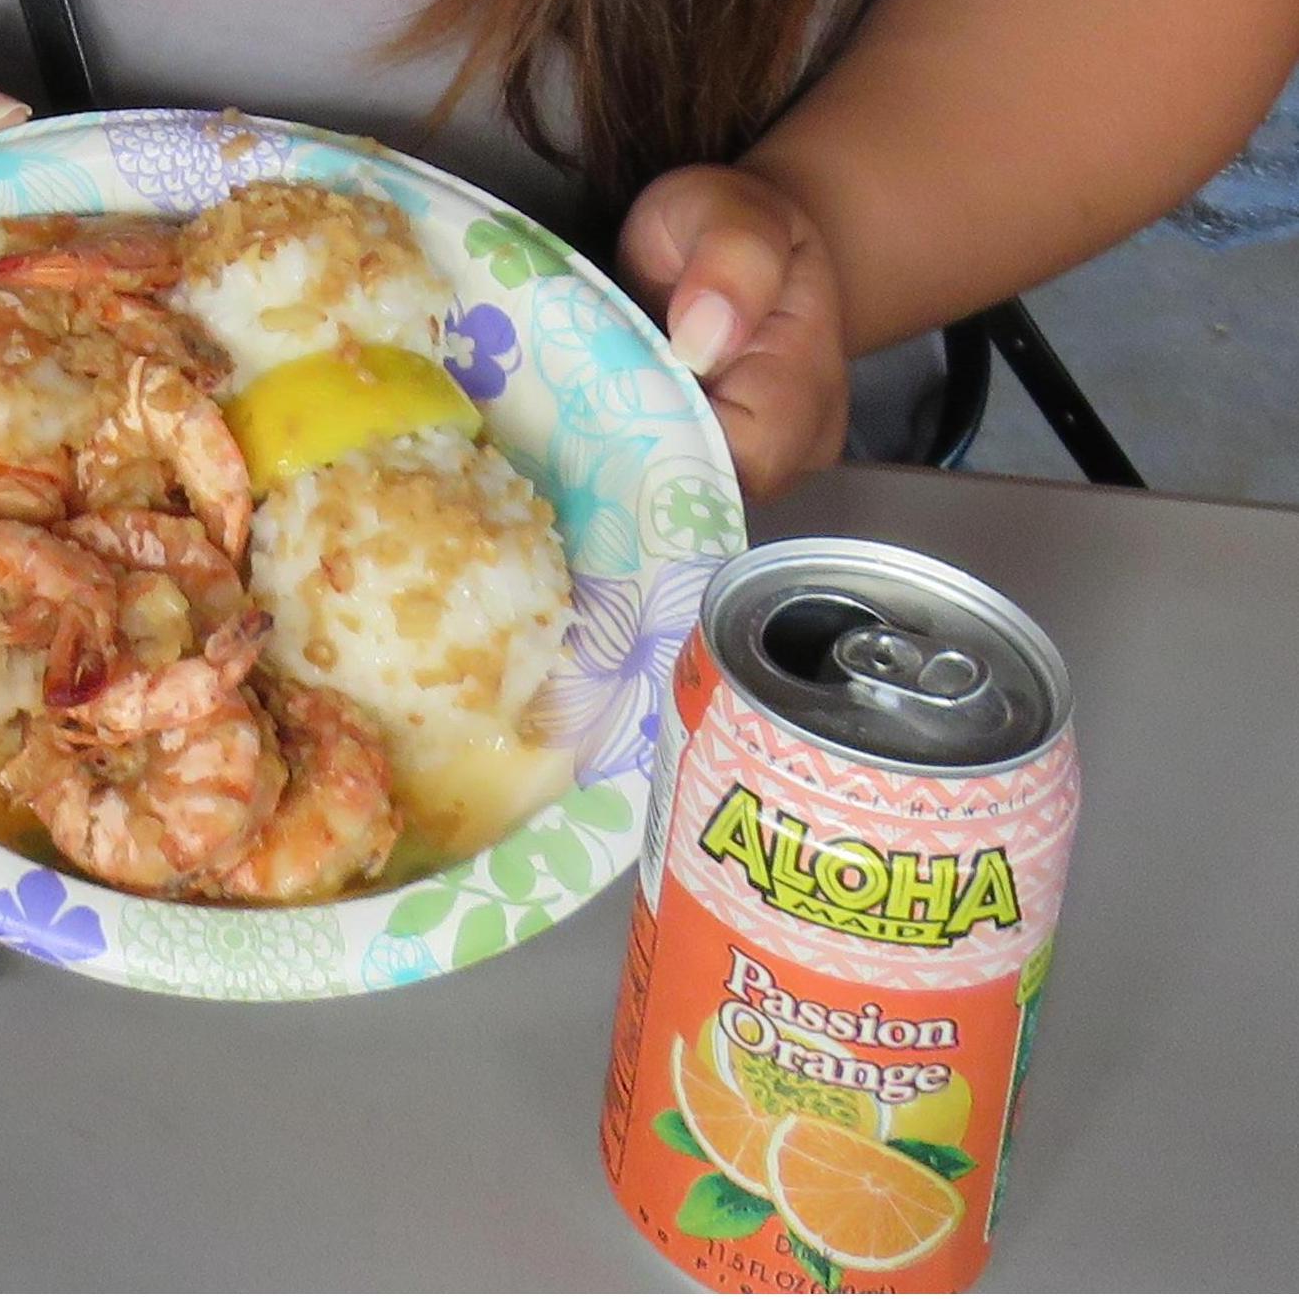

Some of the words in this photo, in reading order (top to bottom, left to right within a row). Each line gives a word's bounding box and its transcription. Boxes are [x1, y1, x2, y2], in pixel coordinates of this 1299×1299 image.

[699, 783, 1022, 938] ALOHA
[792, 901, 935, 939] MAID
[724, 945, 958, 1051] Passion
[718, 999, 952, 1104] Orange
[748, 1259, 771, 1284] FL
